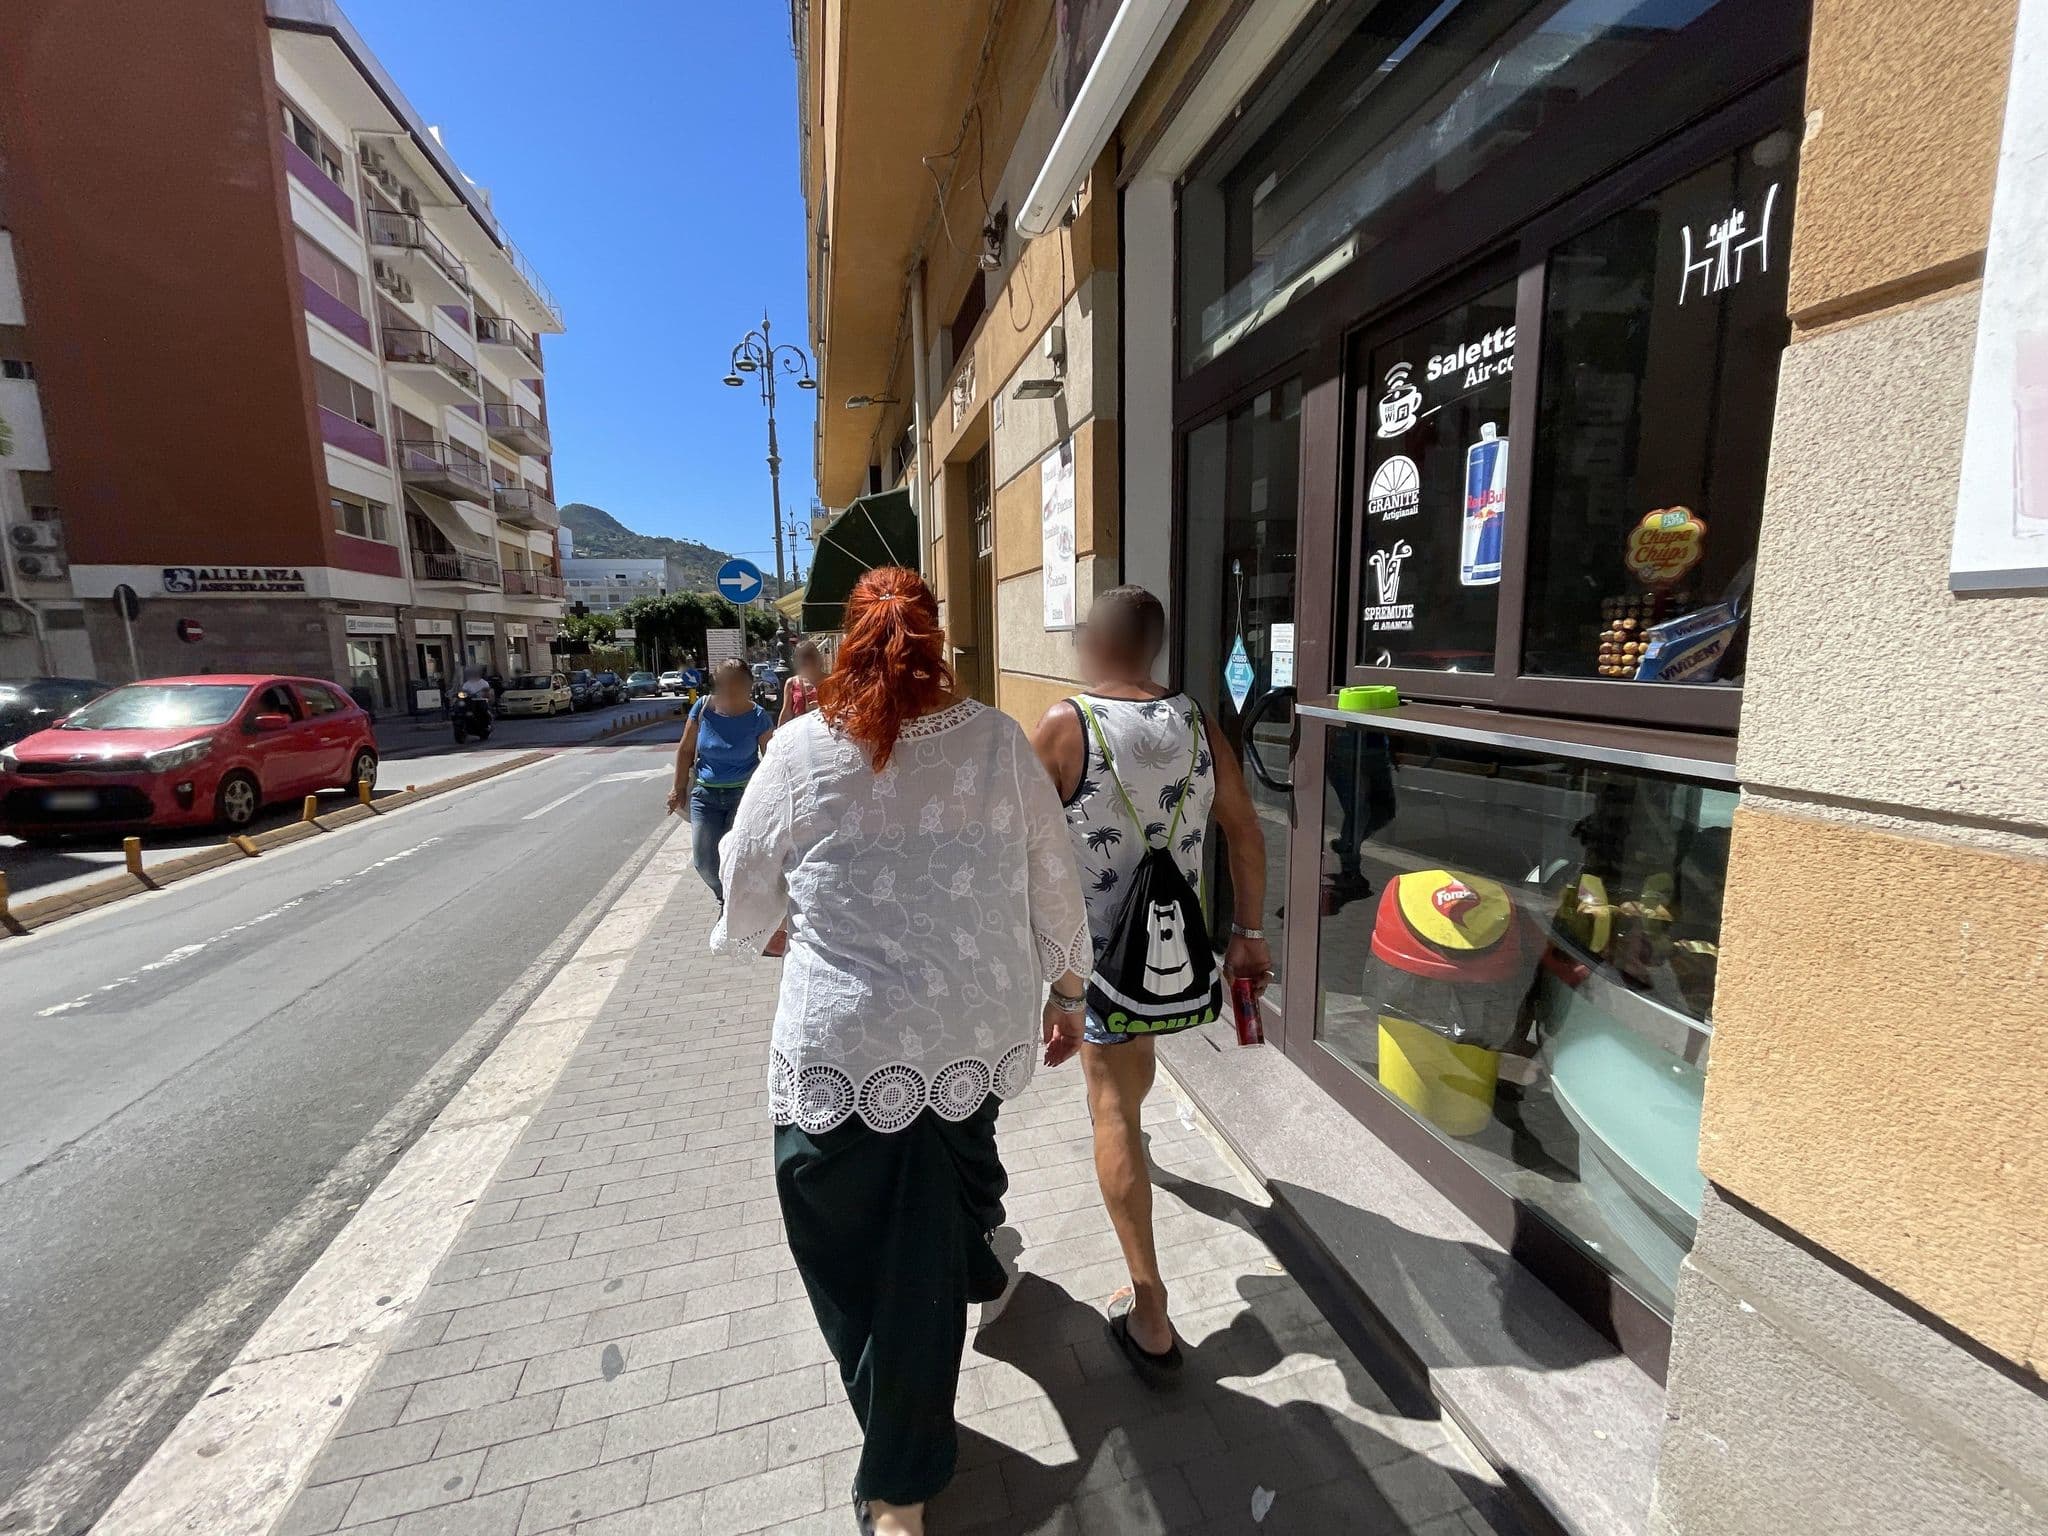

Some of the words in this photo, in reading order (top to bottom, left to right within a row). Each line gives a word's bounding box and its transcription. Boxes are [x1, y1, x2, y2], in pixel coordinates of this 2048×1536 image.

[1426, 325, 1516, 381] Saletta
[1368, 489, 1420, 514] GRANITE
[1382, 504, 1419, 520] Artigianali
[1634, 545, 1690, 568] Chups
[198, 568, 304, 581] ALLEANZA
[1364, 604, 1414, 621] SPREMUTE
